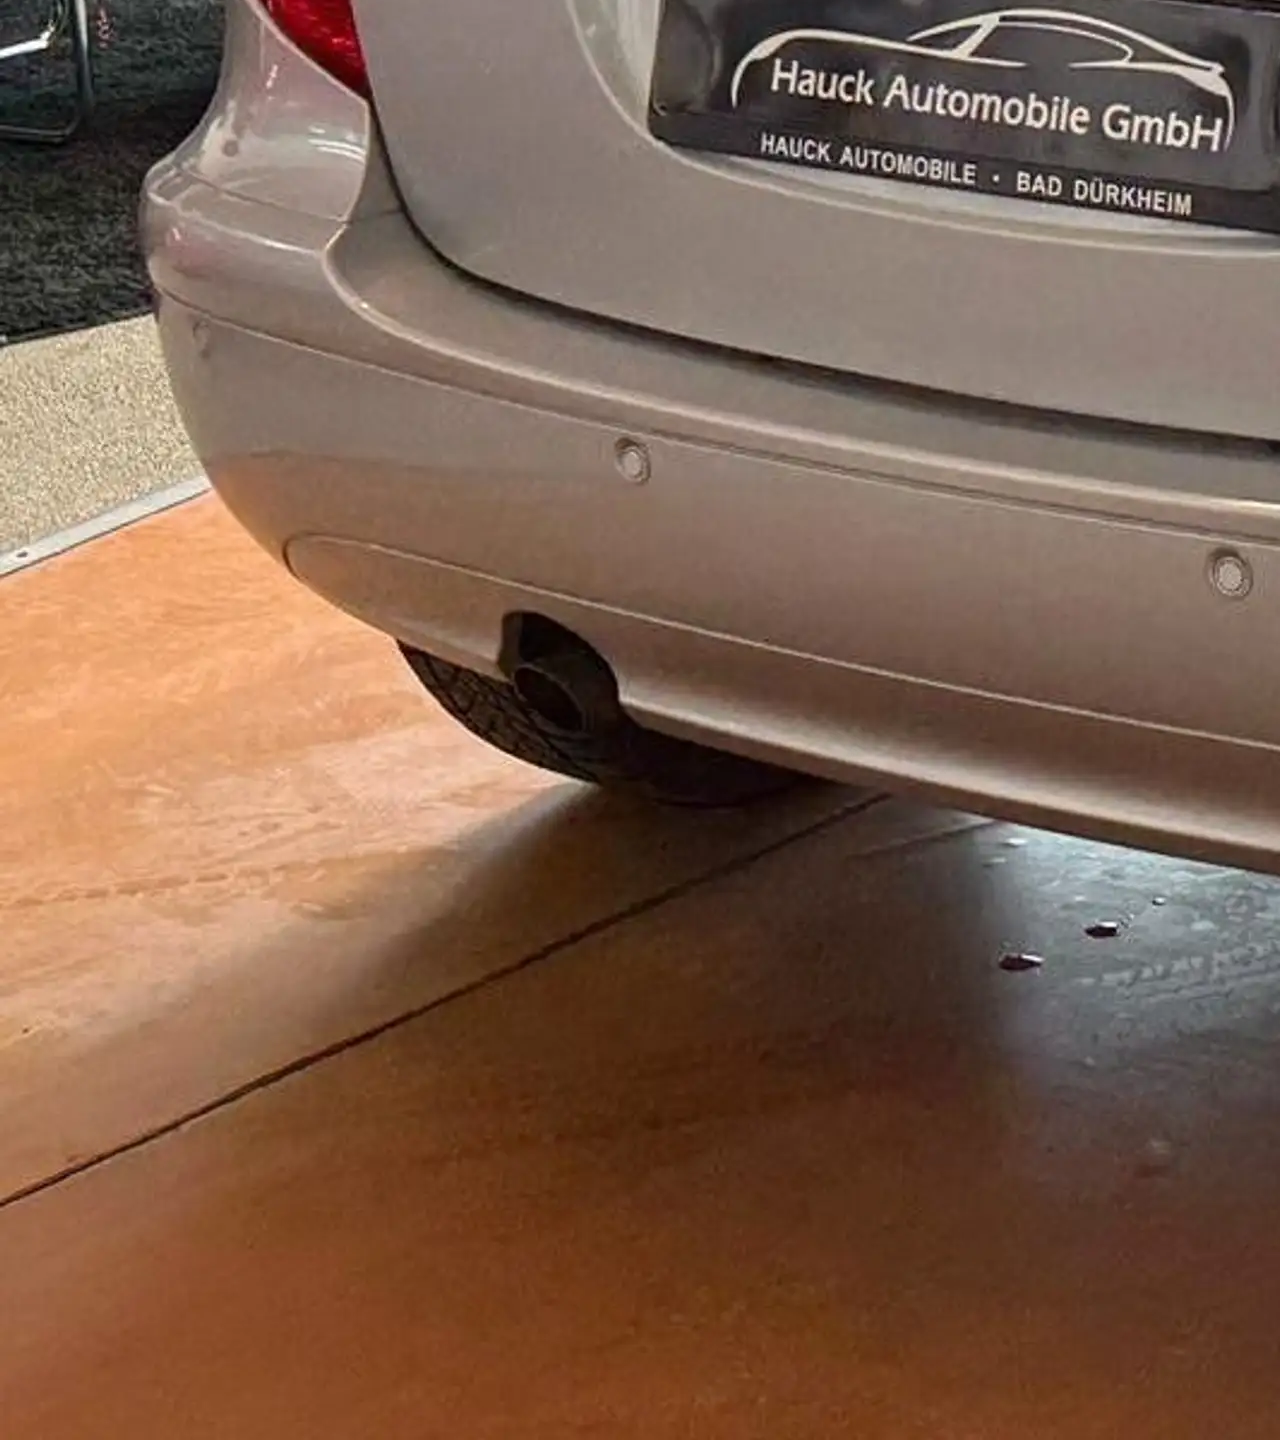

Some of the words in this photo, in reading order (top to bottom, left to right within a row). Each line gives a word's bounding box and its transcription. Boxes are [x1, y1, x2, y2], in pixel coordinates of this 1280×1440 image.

[770, 57, 876, 107] Hauck
[882, 73, 1091, 136] Automobile
[1101, 103, 1223, 153] GmbH
[760, 132, 832, 164] HAUCK
[838, 145, 978, 185] AUTOMOBILE
[1016, 170, 1063, 197] BAD
[1072, 176, 1193, 216] DÜRKHEIM
